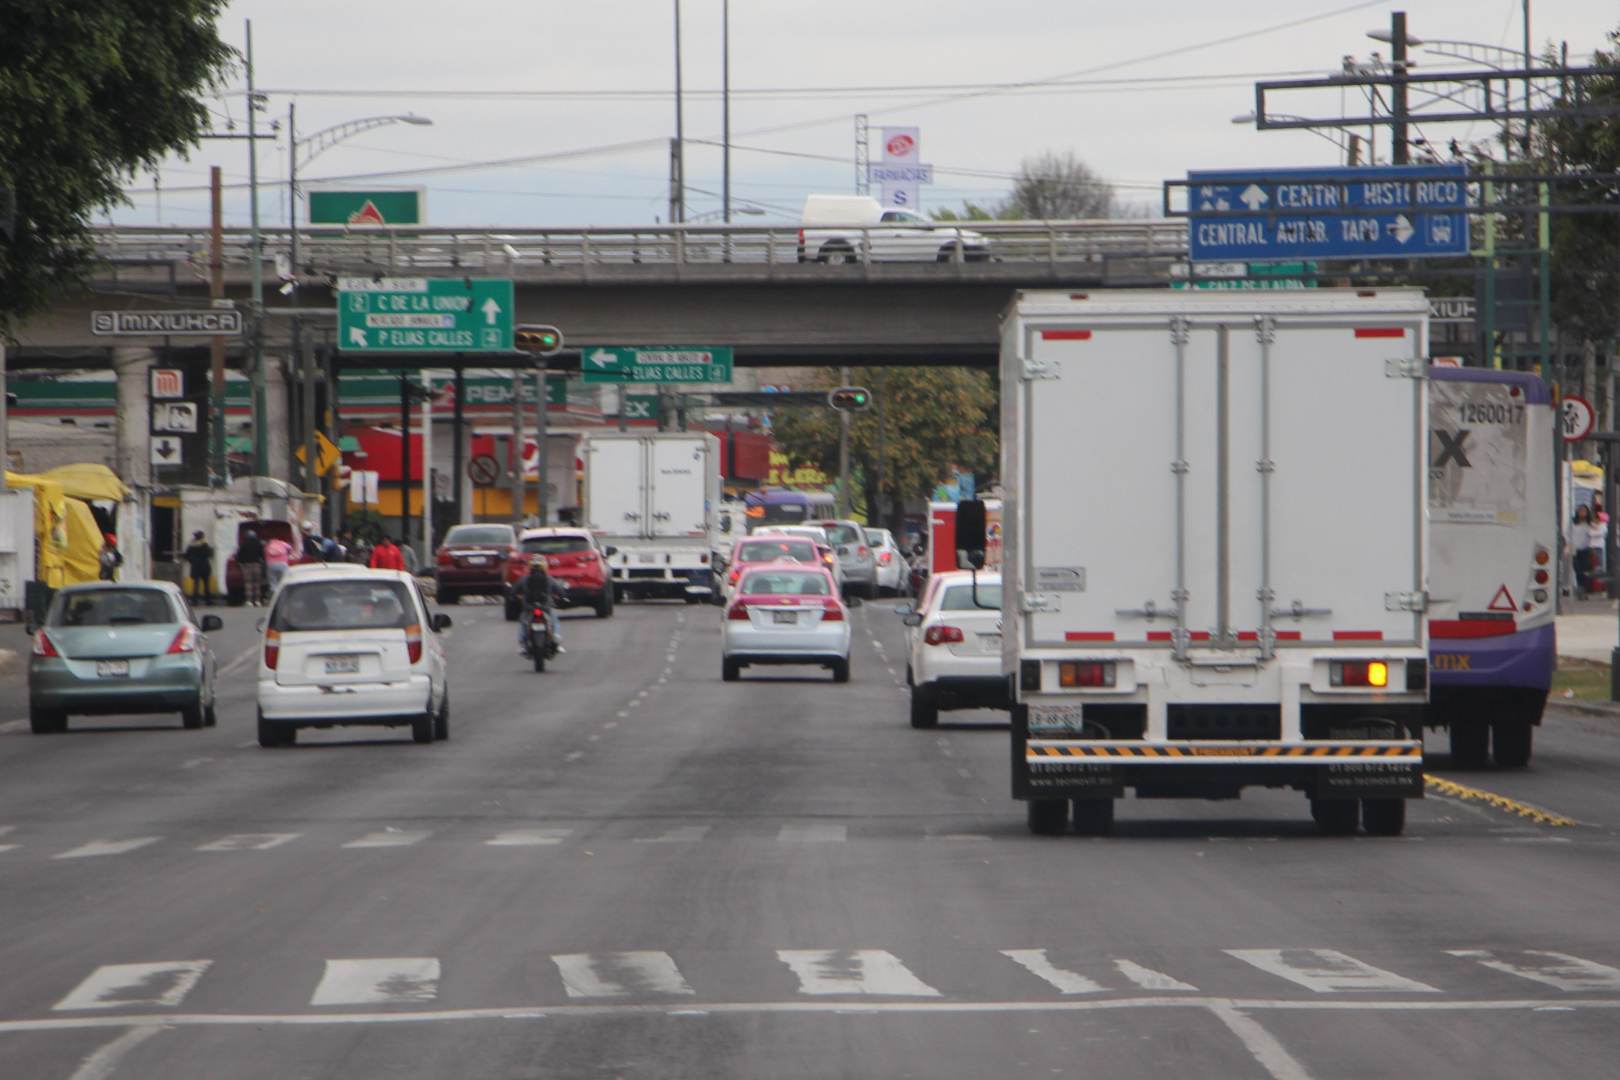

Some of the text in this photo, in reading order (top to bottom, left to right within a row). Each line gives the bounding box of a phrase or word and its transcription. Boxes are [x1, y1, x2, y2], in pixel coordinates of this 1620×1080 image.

[893, 190, 907, 205] S
[1199, 222, 1268, 246] CENTRAL
[1341, 219, 1380, 241] TAPO
[391, 295, 408, 310] DE
[411, 295, 429, 310] LA
[391, 331, 424, 346] ELIAS
[428, 331, 473, 346] CALLES
[665, 366, 704, 380] CALLES
[1460, 402, 1524, 424] 1260017
